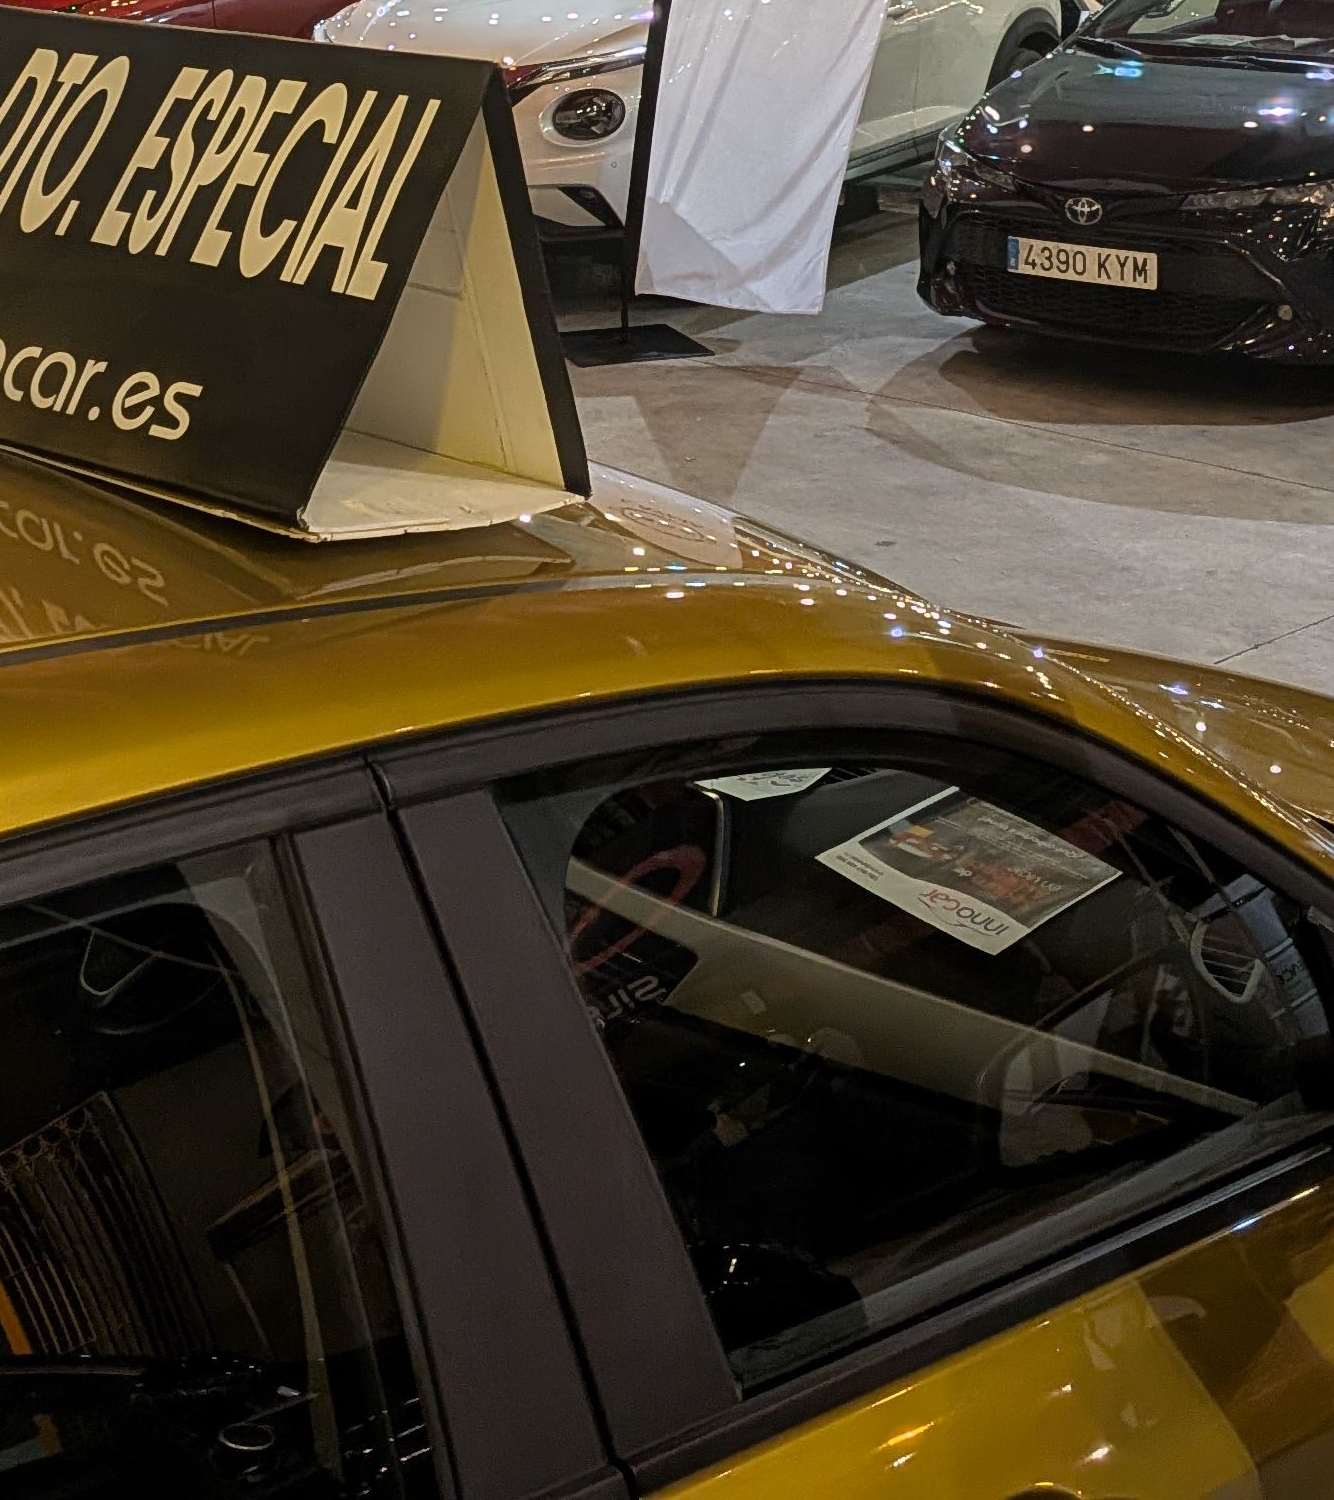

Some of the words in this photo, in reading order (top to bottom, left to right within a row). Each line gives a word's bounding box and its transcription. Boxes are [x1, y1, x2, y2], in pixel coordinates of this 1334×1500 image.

[89, 66, 442, 301] ESPECIAL
[1023, 244, 1087, 276] 4390
[1097, 252, 1148, 284] KYM
